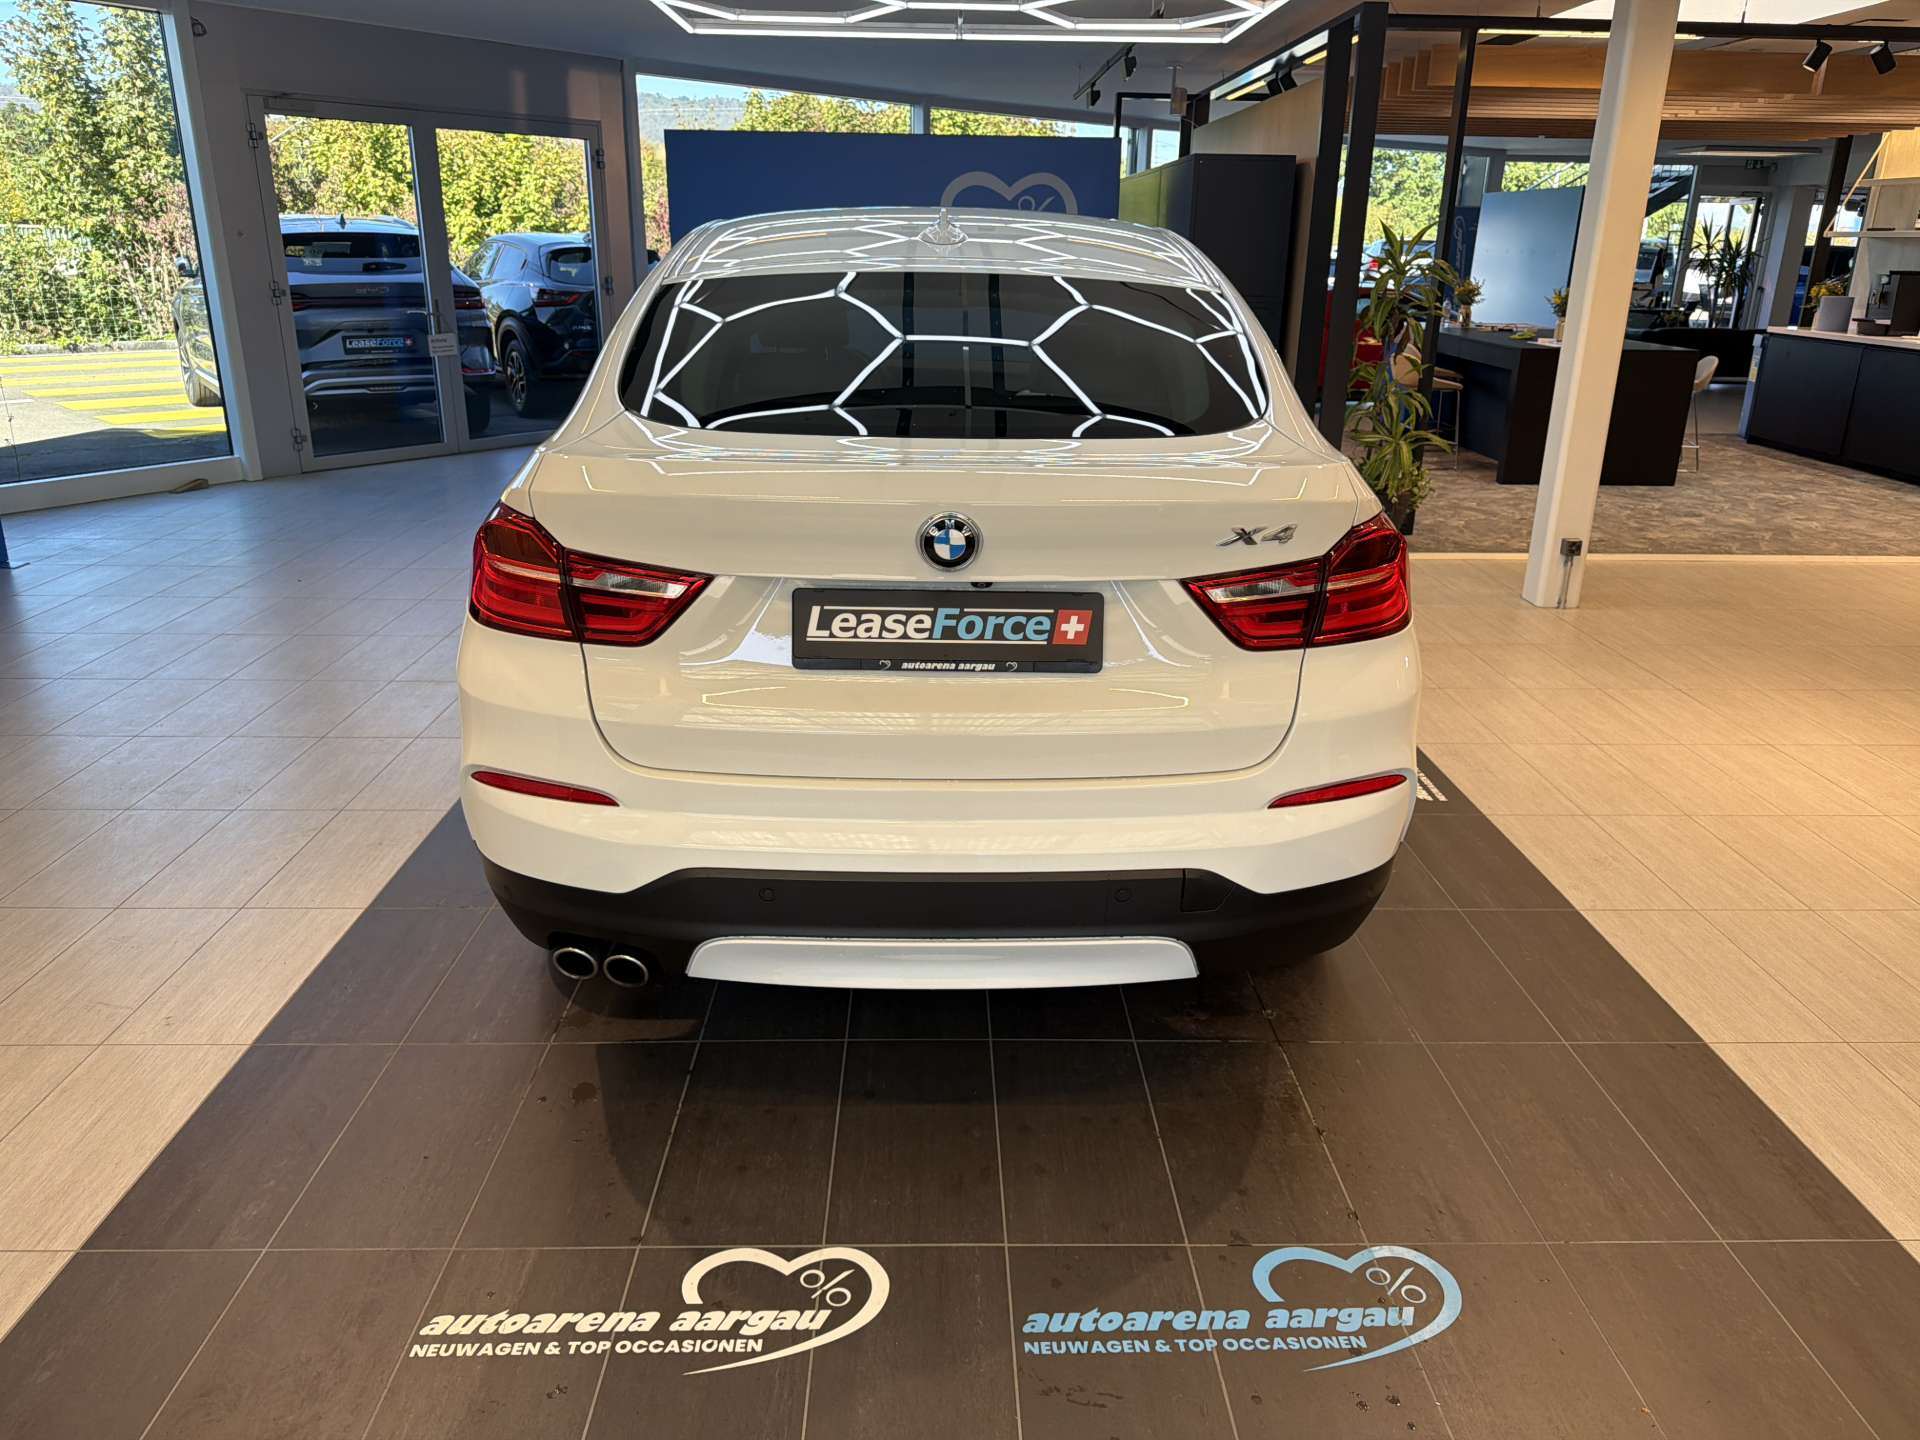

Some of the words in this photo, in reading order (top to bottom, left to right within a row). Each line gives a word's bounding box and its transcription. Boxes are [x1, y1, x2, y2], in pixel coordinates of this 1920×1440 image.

[928, 519, 973, 538] BMW
[1216, 524, 1298, 546] X4
[806, 605, 1051, 640] LeaseForce
[901, 661, 955, 670] autoarena
[958, 662, 996, 671] aargau
[419, 1309, 660, 1336] autoarena
[669, 1309, 831, 1335] aargau
[1022, 1308, 1250, 1333] autoarena
[1264, 1307, 1415, 1332] aargau
[409, 1341, 540, 1358] NEUWAGEN
[544, 1341, 561, 1355] &
[566, 1340, 610, 1355] TOP
[615, 1338, 762, 1353] OCCASIONEN
[1023, 1338, 1150, 1355] NEUWAGEN
[1154, 1338, 1173, 1353] &
[1175, 1336, 1219, 1353] TOP
[1223, 1335, 1367, 1352] OCCASIONEN
